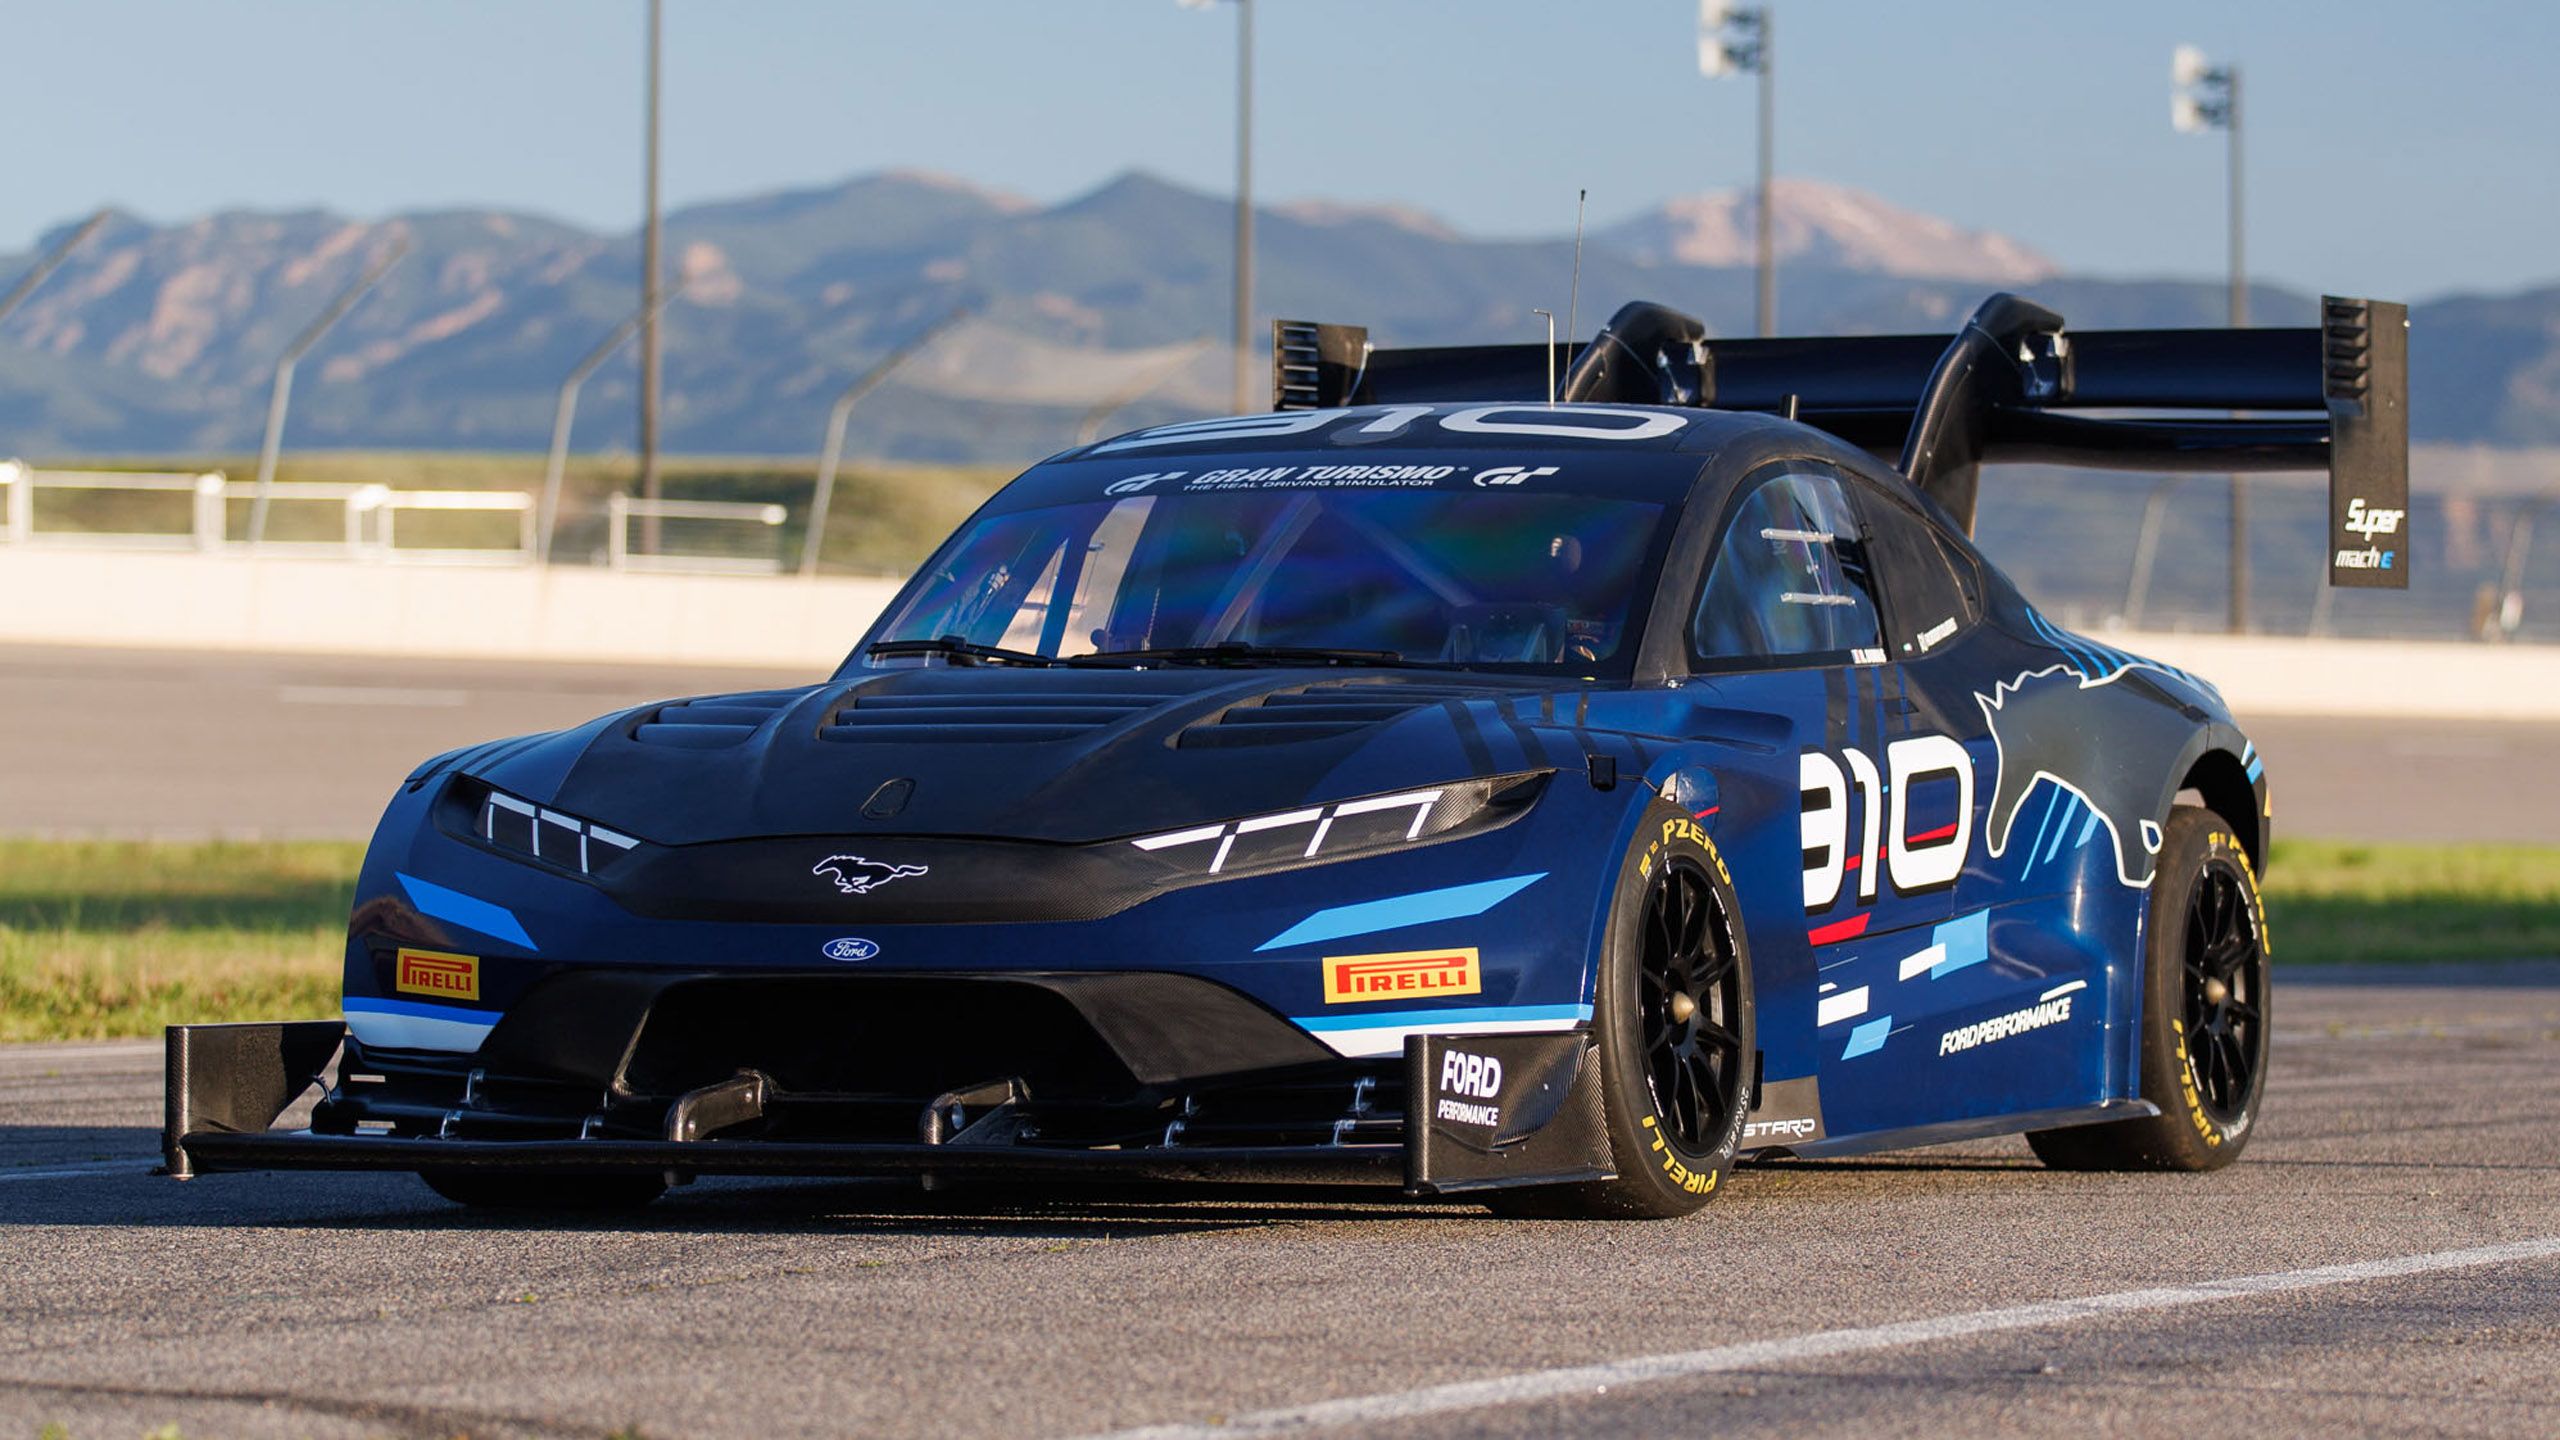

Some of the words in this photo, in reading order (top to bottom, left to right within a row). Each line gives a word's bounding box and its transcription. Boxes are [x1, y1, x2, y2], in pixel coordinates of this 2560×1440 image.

[1192, 466, 1298, 484] GRAN
[1263, 480, 1329, 488] DRIVING
[1333, 479, 1435, 487] SIMULATOR
[2344, 498, 2405, 542] Super
[832, 941, 869, 957] Ford
[402, 955, 473, 992] PIRELLI
[1335, 956, 1468, 994] PIRELLI
[1440, 1049, 1502, 1099] FORD
[1436, 1099, 1499, 1127] PERFORMANCE
[1742, 1118, 1816, 1138] STARD
[1641, 1115, 1718, 1195] PIRELLI
